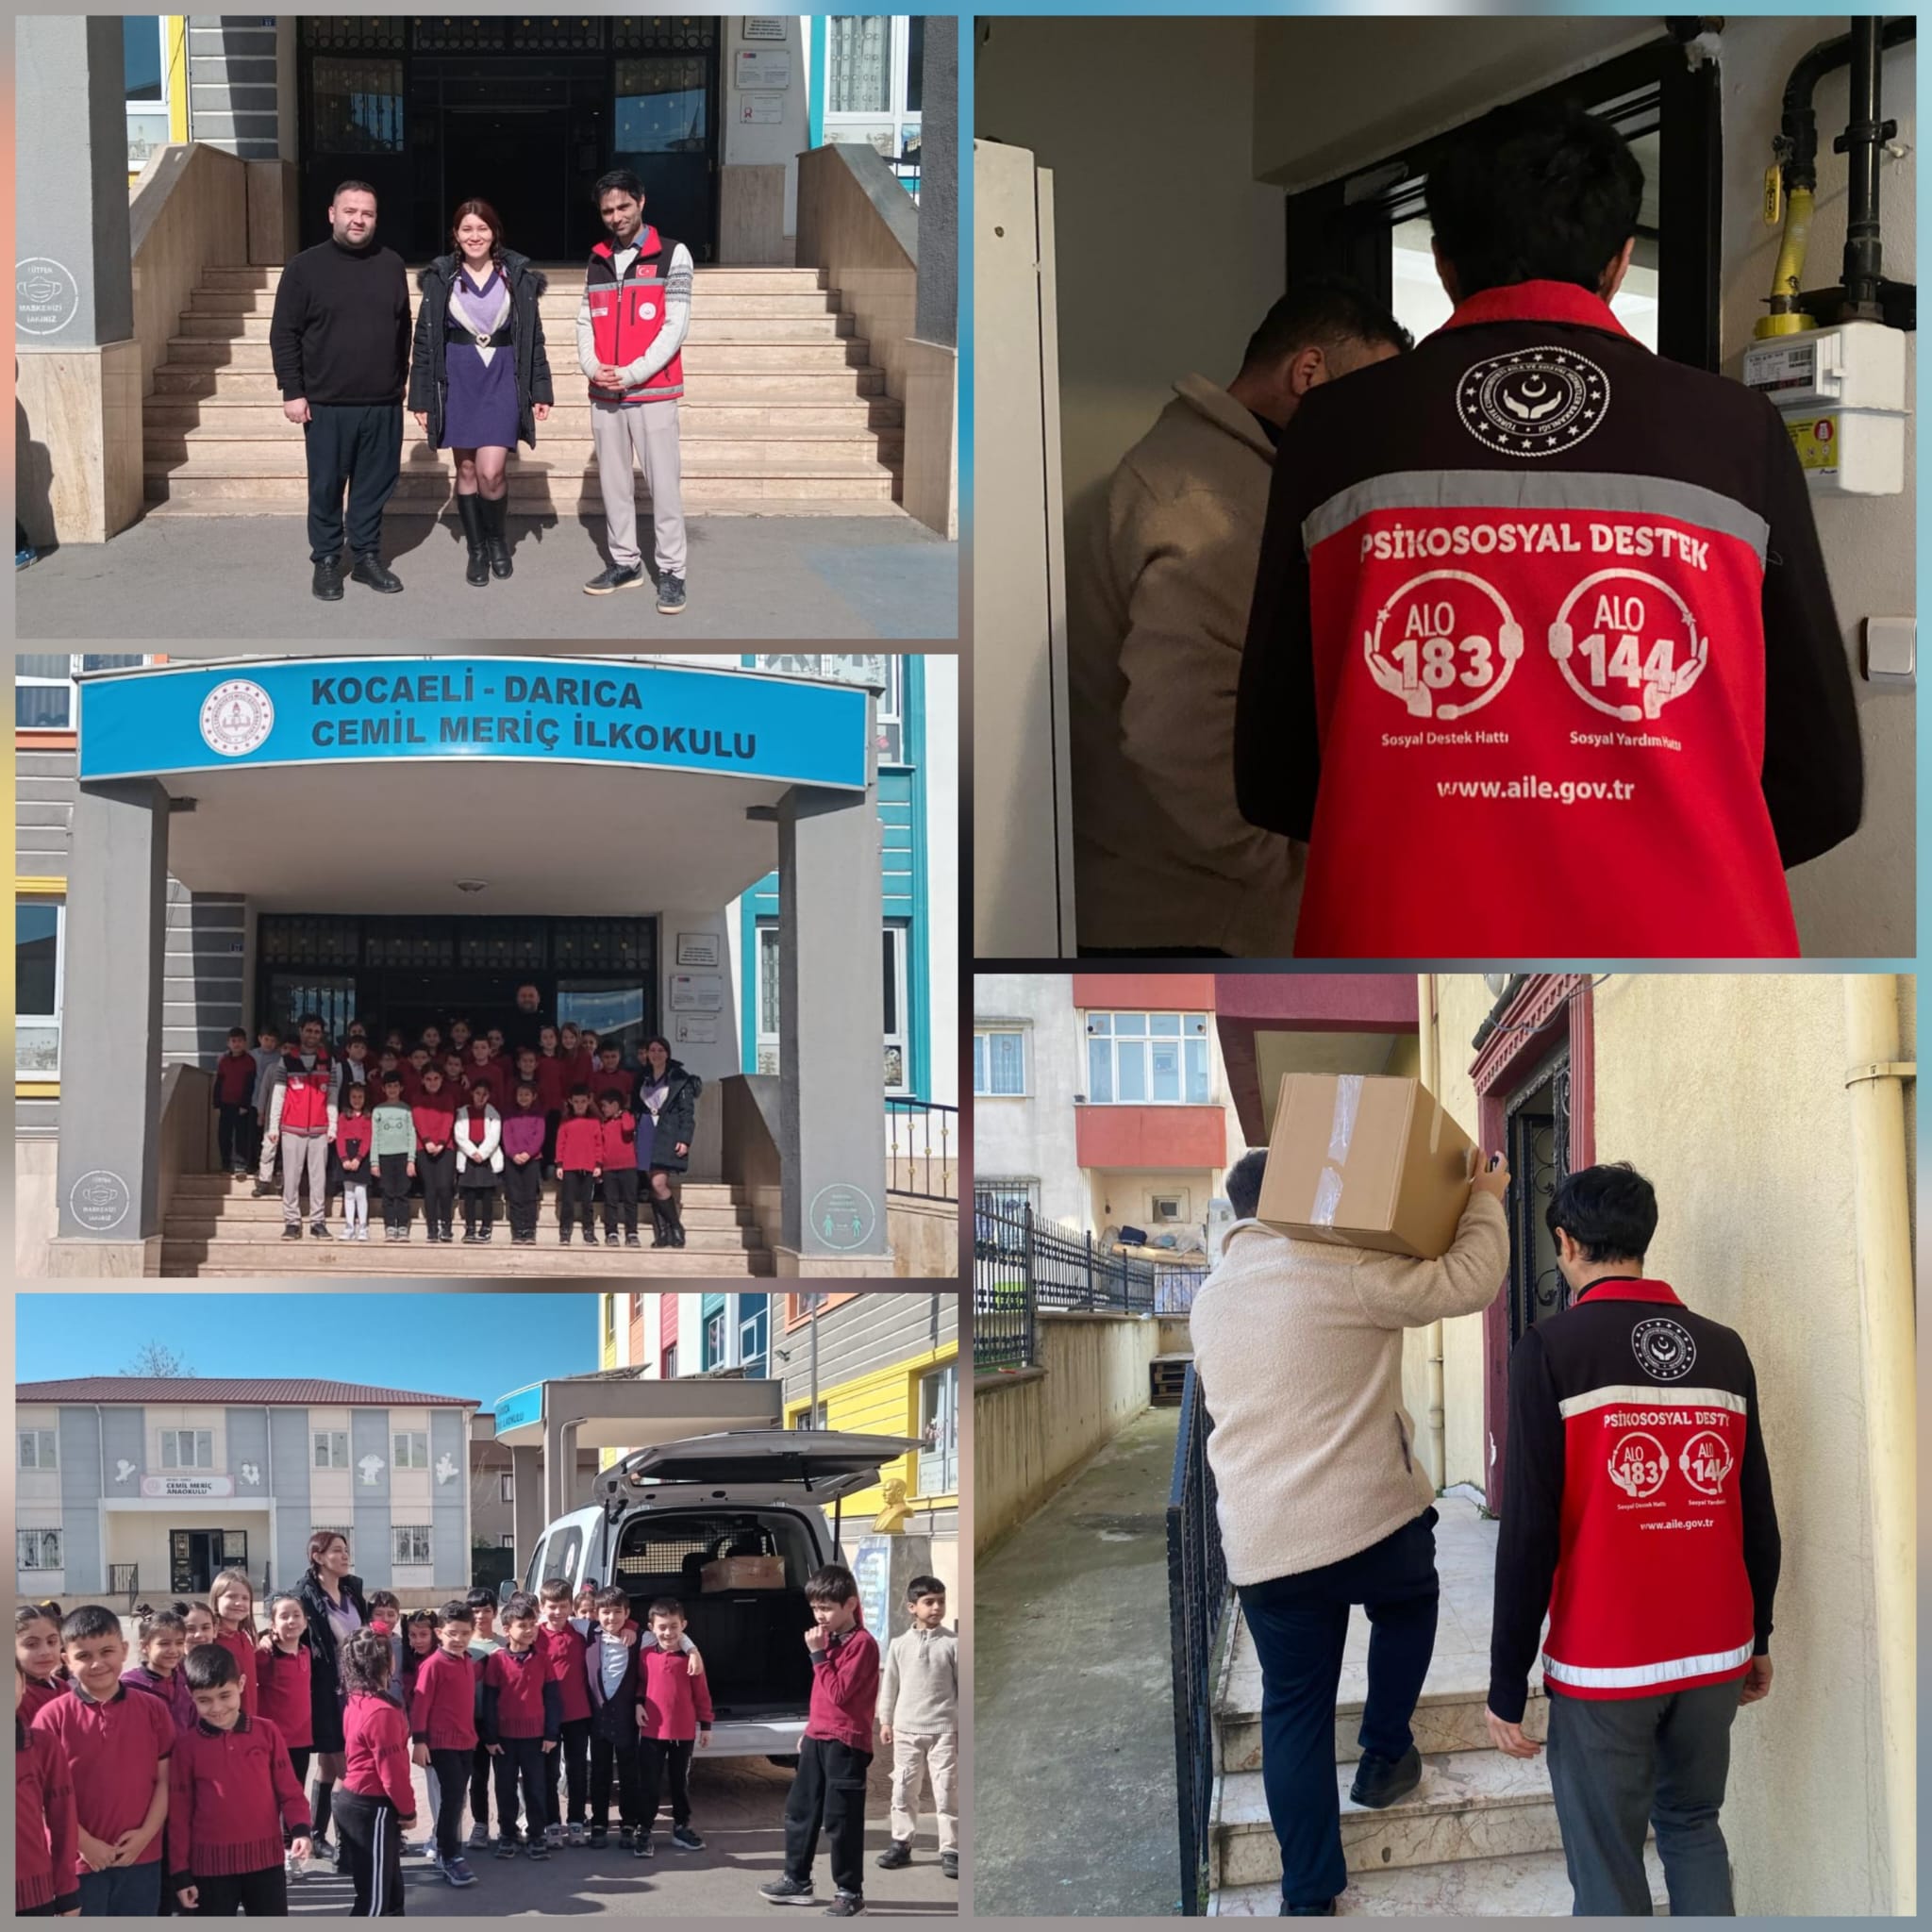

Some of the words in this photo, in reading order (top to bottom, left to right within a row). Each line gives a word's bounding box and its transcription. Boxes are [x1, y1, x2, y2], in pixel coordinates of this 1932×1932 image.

[1360, 523, 1581, 563] PSİKOSOSYAL
[1590, 523, 1709, 571] DESTEK
[1405, 601, 1455, 639] ALO
[1593, 594, 1645, 633] ALO
[1391, 635, 1494, 690] 183
[1577, 633, 1676, 694] 144
[312, 667, 474, 706] KOCAELİ
[505, 675, 643, 710] DARICA
[311, 709, 426, 746] CEMİL
[440, 709, 560, 751] MERİÇ
[574, 711, 757, 759] İLKOKULU
[1381, 731, 1424, 748] Sosyal
[1426, 731, 1473, 744] Destek
[1475, 729, 1509, 743] Hattı
[1570, 730, 1614, 747] Sosyal
[1616, 732, 1663, 747] Yardım
[1436, 774, 1636, 805] www.aile.gov.tr
[1604, 1410, 1692, 1429] PSİKOSOSYAL
[1624, 1445, 1644, 1462] ALO
[1619, 1460, 1659, 1485] 183
[1640, 1518, 1714, 1531] www.aile.gov.tr
